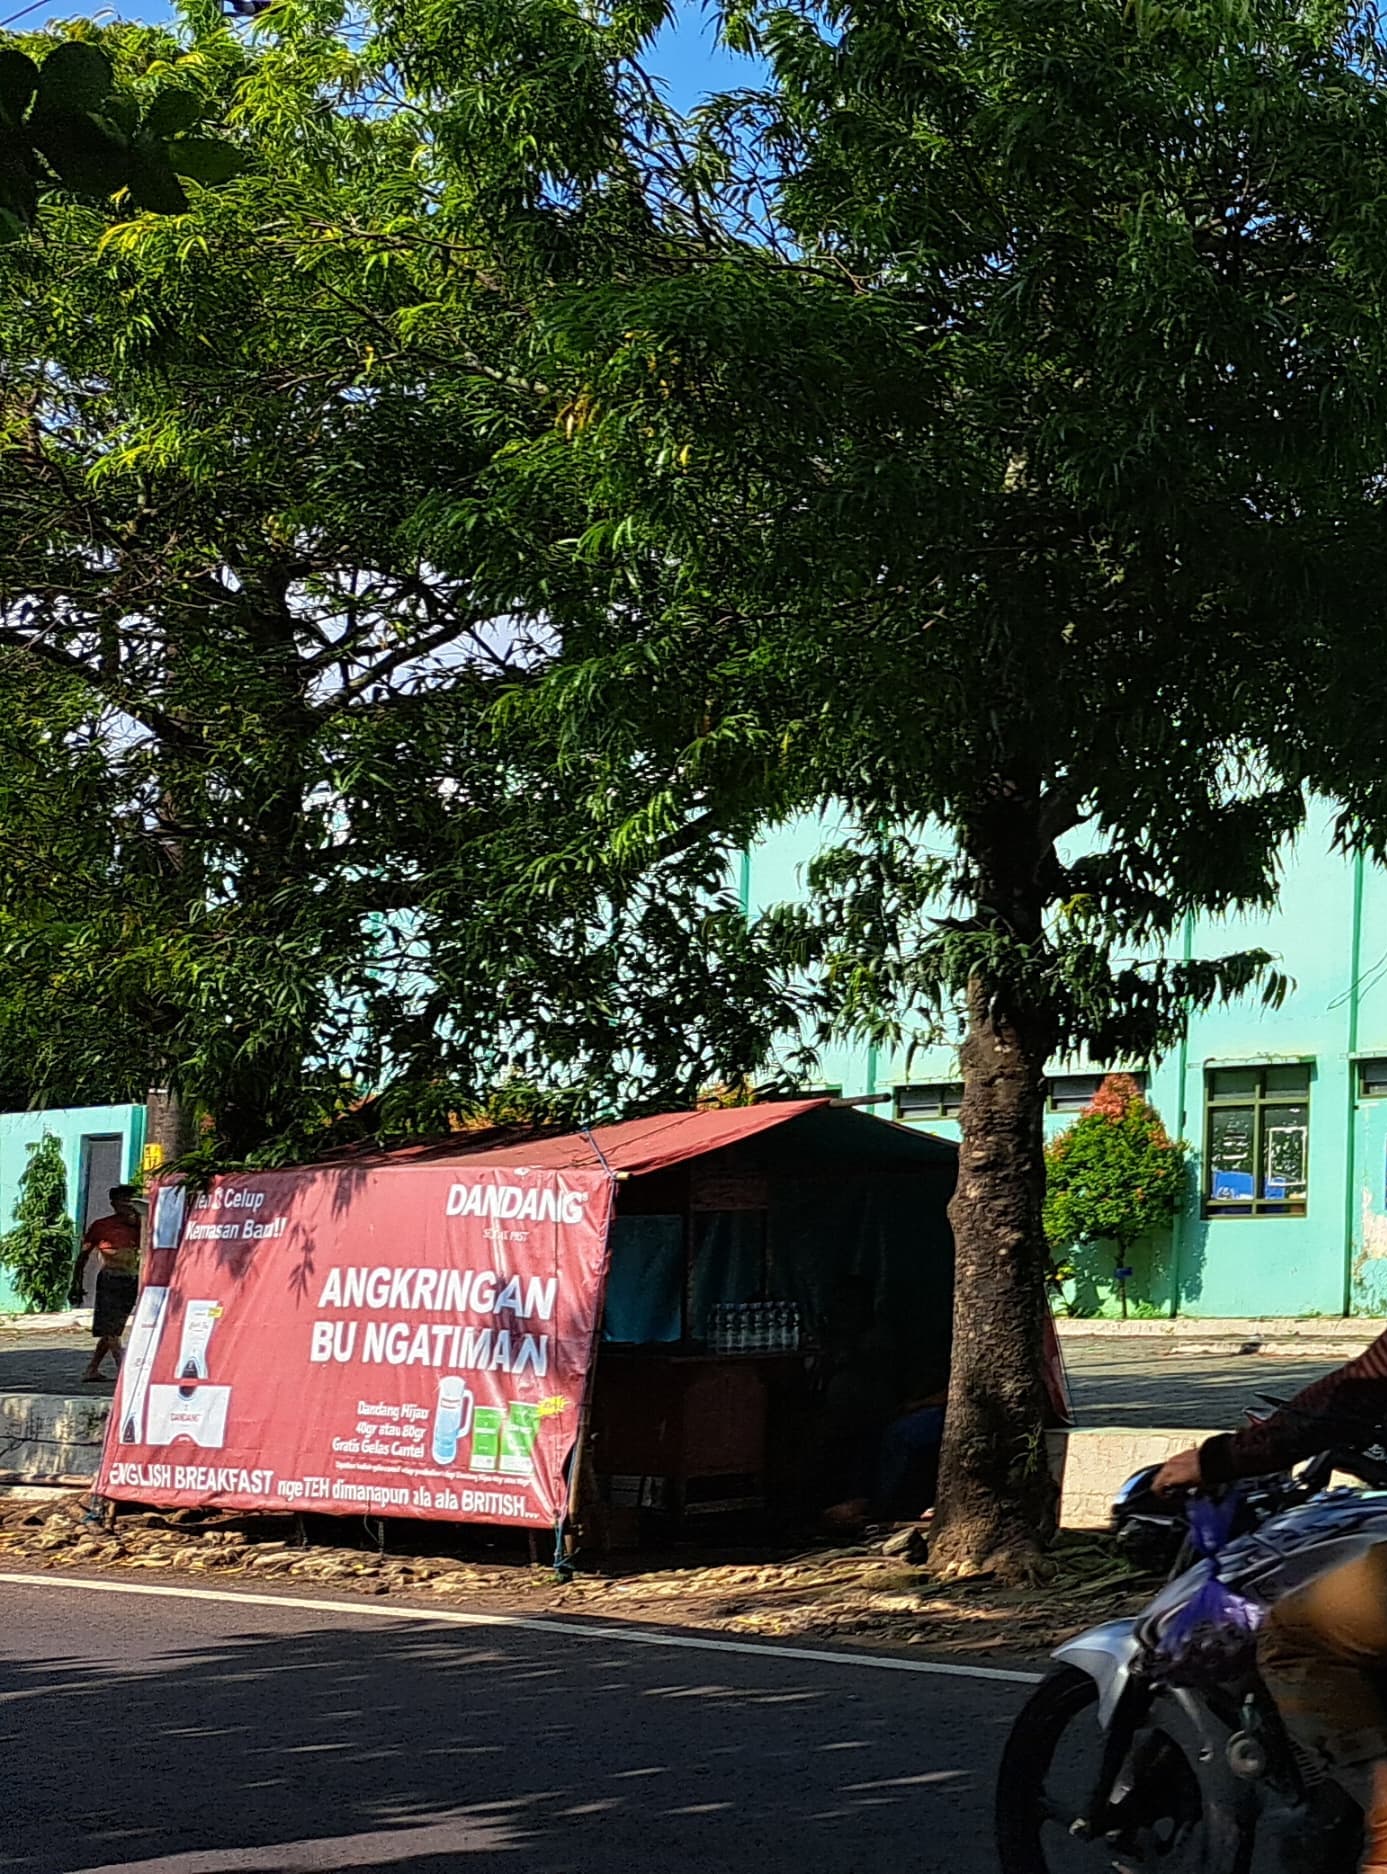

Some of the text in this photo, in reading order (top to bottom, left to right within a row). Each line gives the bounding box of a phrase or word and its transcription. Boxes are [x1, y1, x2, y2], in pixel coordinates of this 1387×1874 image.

[224, 1188, 265, 1213] Celup
[445, 1183, 585, 1224] DANDANG
[184, 1221, 239, 1240] Kemasan
[317, 1267, 557, 1320] ANGKRINGAN
[310, 1321, 548, 1376] BU NGATIMAN
[357, 1400, 400, 1421] Dandang
[332, 1437, 360, 1452] Gratis
[361, 1438, 390, 1455] Gelas
[109, 1462, 171, 1488] ENGLISH
[174, 1466, 274, 1494] BREAKFAST
[277, 1477, 330, 1501] ngeTEH
[333, 1480, 409, 1507] dimanapun
[435, 1488, 458, 1510] ala
